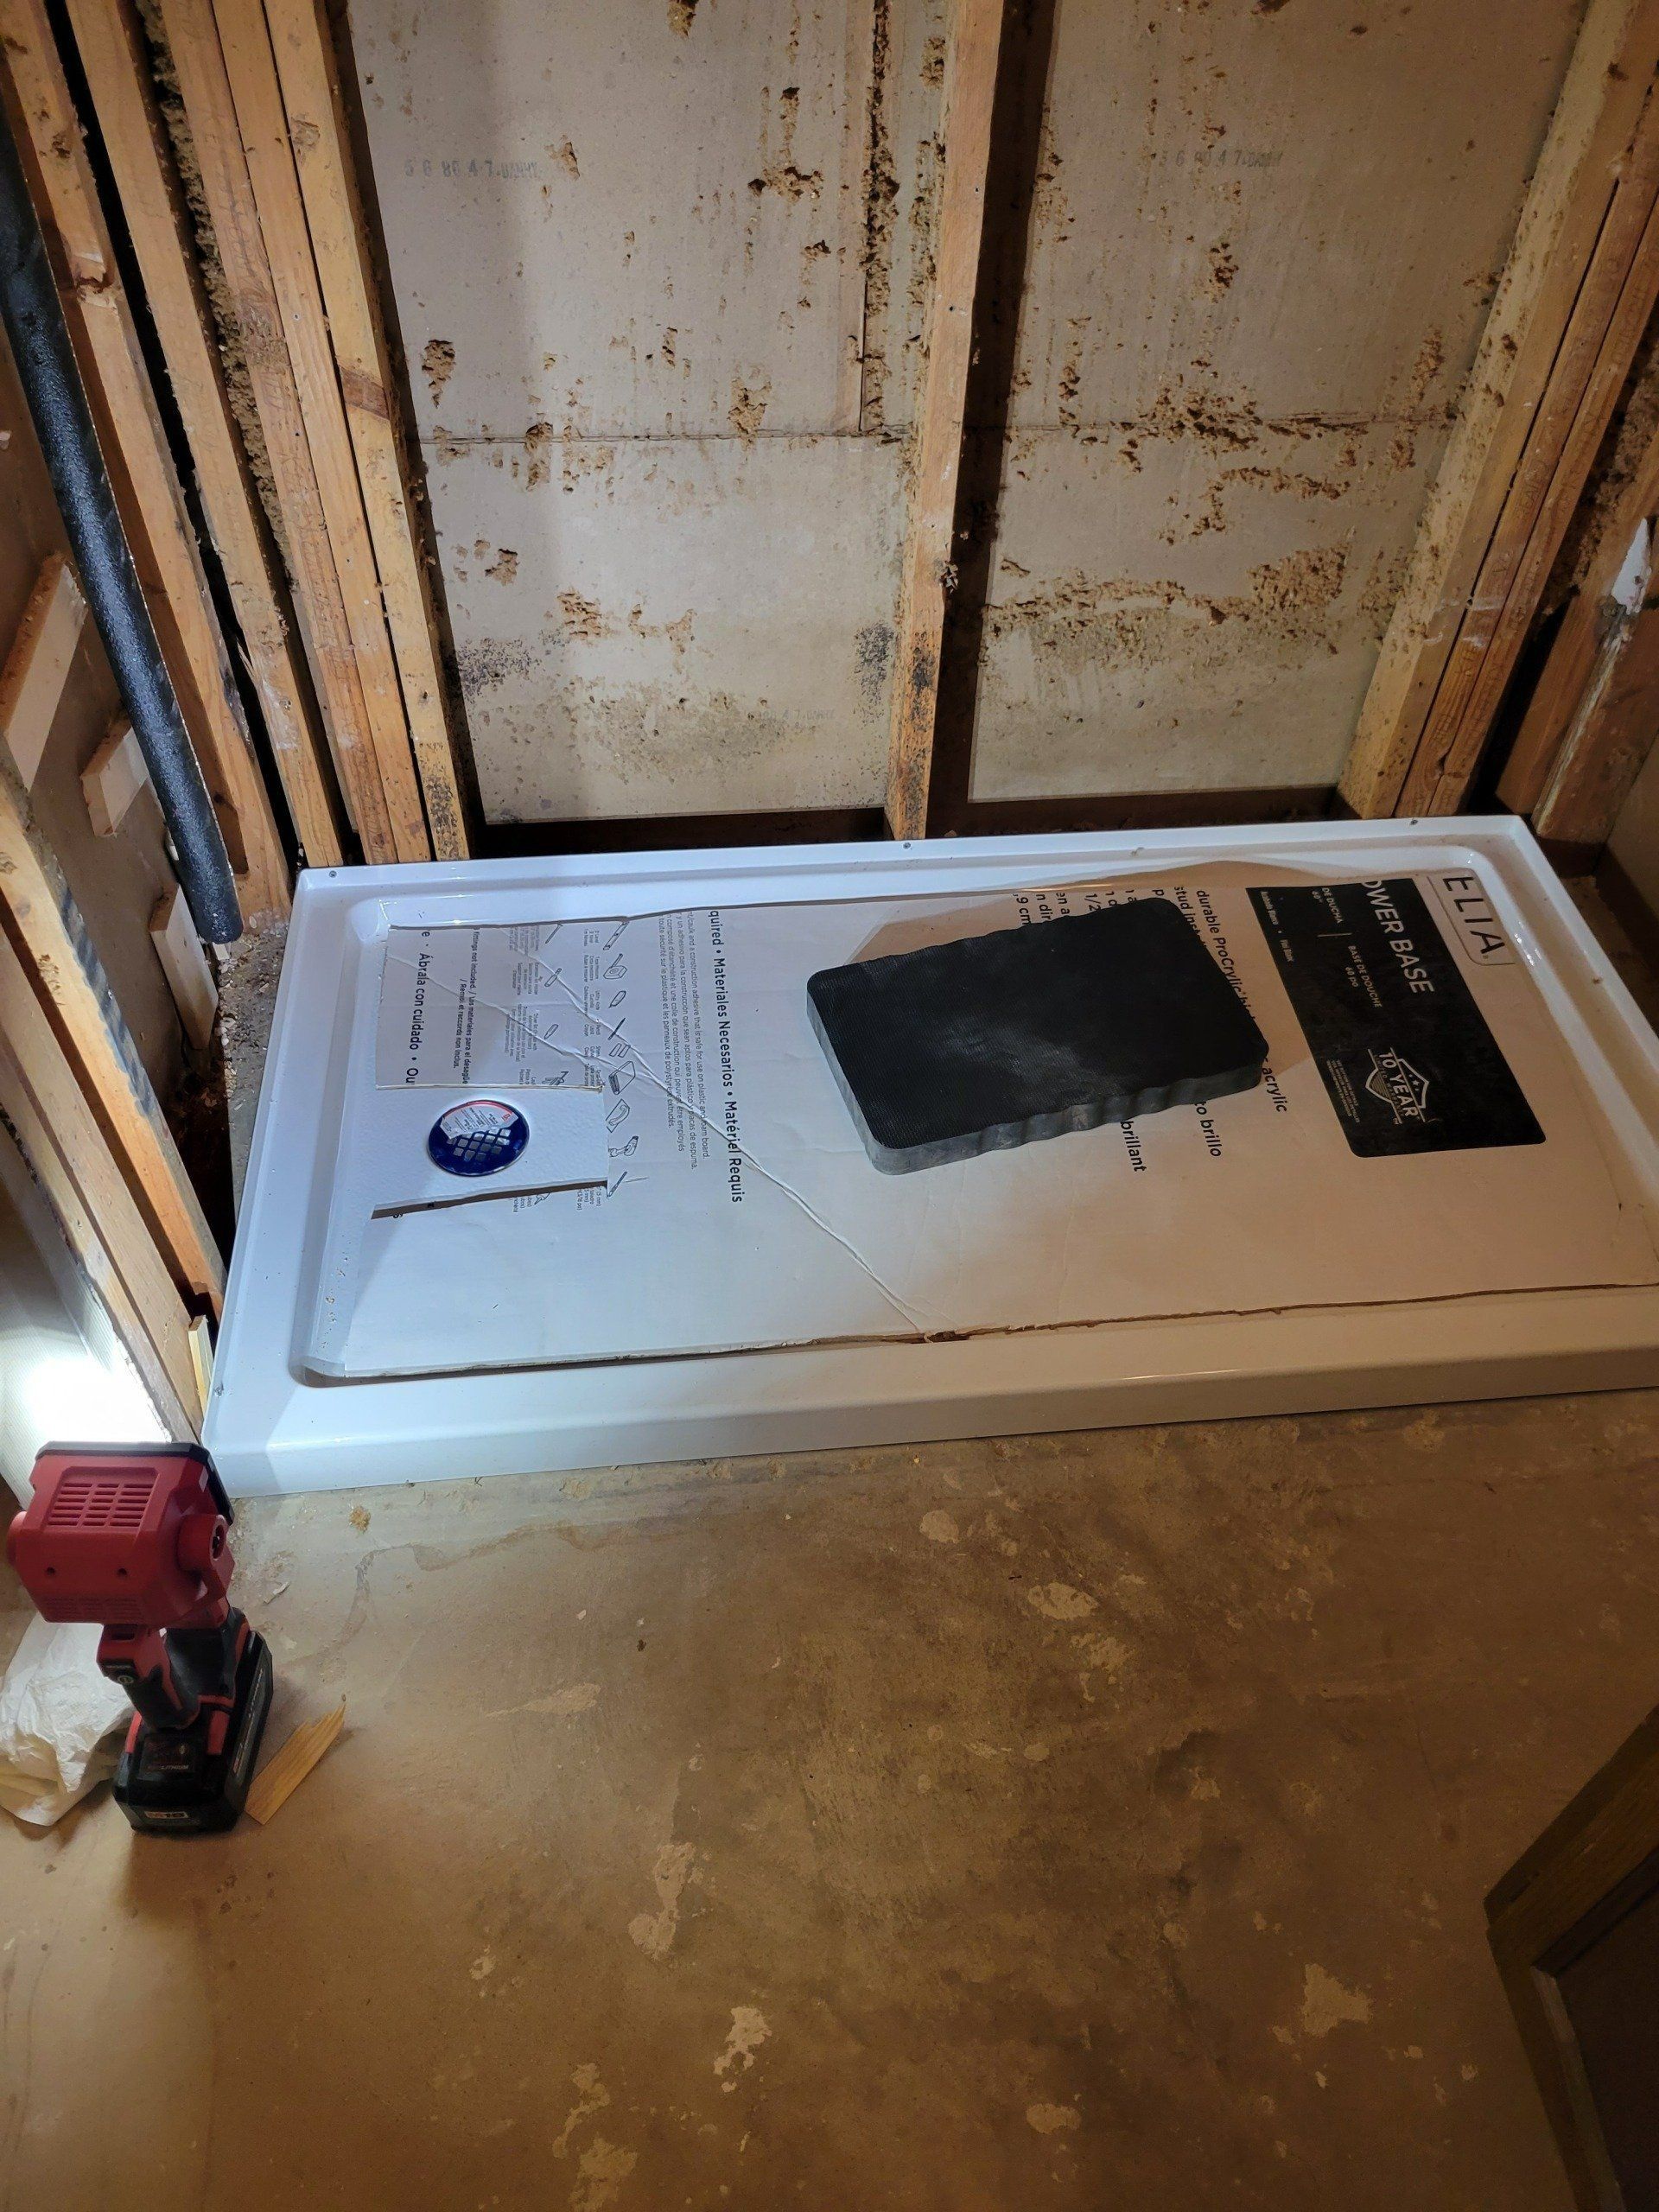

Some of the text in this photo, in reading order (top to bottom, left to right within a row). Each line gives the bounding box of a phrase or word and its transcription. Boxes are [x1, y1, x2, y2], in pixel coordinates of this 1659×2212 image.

[1196, 890, 1221, 934] durable
[1326, 897, 1344, 924] DUCHA
[416, 952, 433, 985] Ábrala
[1348, 945, 1382, 1007] BASE DE DOUCHE
[1389, 939, 1434, 993] BASE
[414, 988, 426, 1006] con
[409, 1008, 425, 1049] cuidado
[690, 952, 698, 988] construction
[696, 1084, 706, 1103] plastic
[405, 1068, 418, 1084] Ou
[708, 911, 744, 1202] quired Materiales Necesarios Matériel Requis
[685, 1078, 694, 1102] plástico
[1262, 1068, 1287, 1112] acrylic
[1379, 1052, 1419, 1116] 10 YEAR
[676, 1120, 685, 1151] employés
[1120, 1121, 1147, 1172] brillant
[1200, 1119, 1223, 1157] brillo
